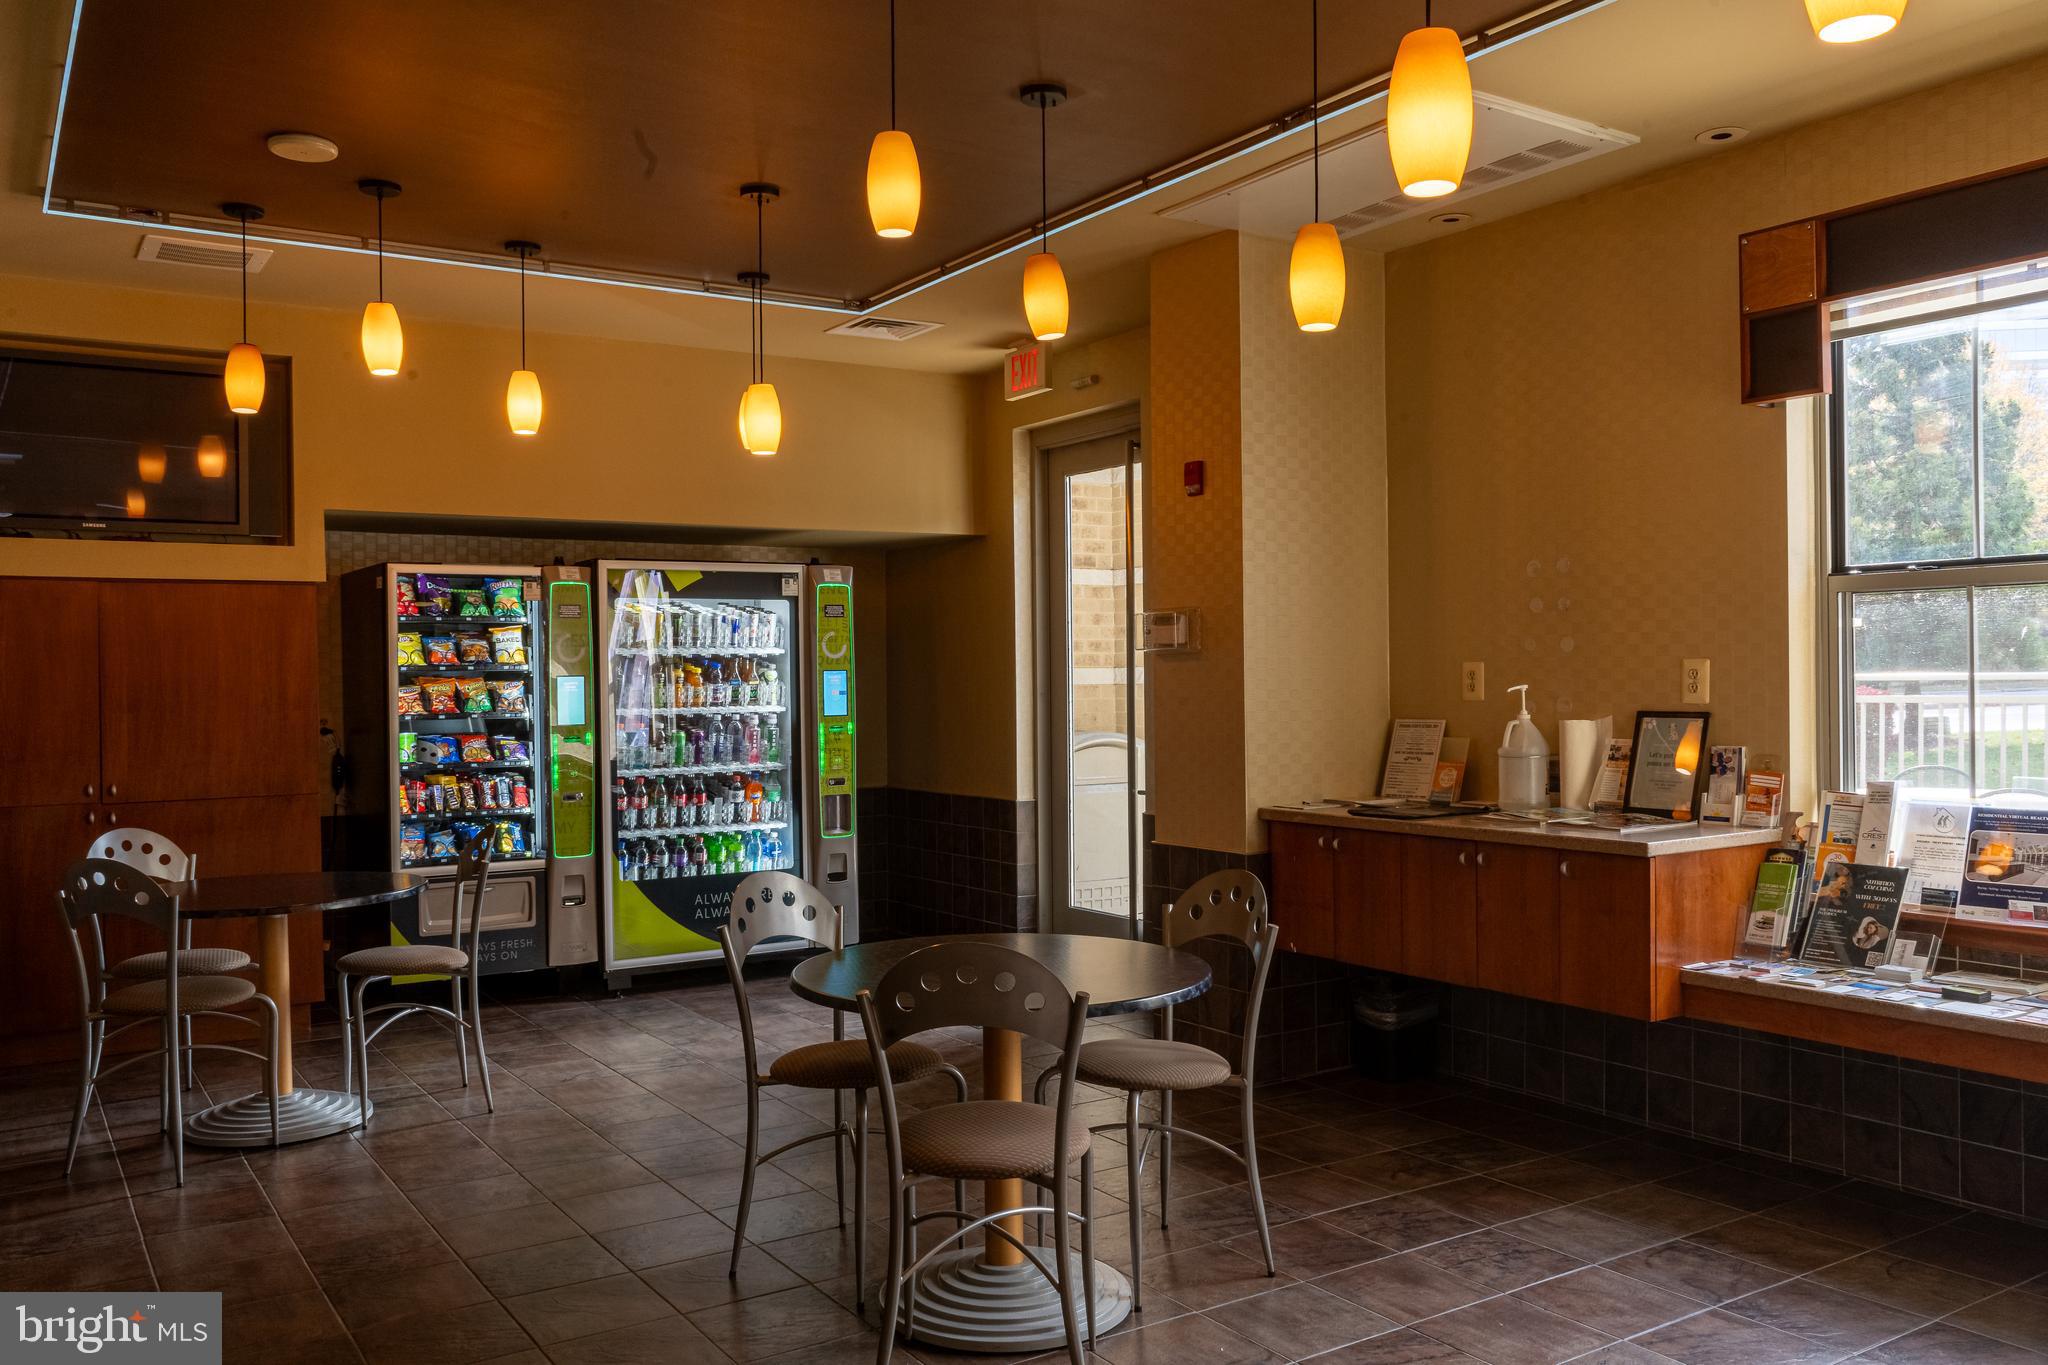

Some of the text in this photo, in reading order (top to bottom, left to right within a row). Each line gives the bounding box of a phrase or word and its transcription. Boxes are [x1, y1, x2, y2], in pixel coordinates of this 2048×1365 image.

[1011, 348, 1039, 392] EXIT
[1862, 832, 1887, 840] CREST
[1865, 879, 1896, 887] NUTRITION
[1863, 884, 1895, 892] COACHING
[695, 891, 734, 905] ALWA
[1855, 893, 1871, 901] WITH
[695, 906, 731, 919] ALWA
[500, 951, 518, 960] ON
